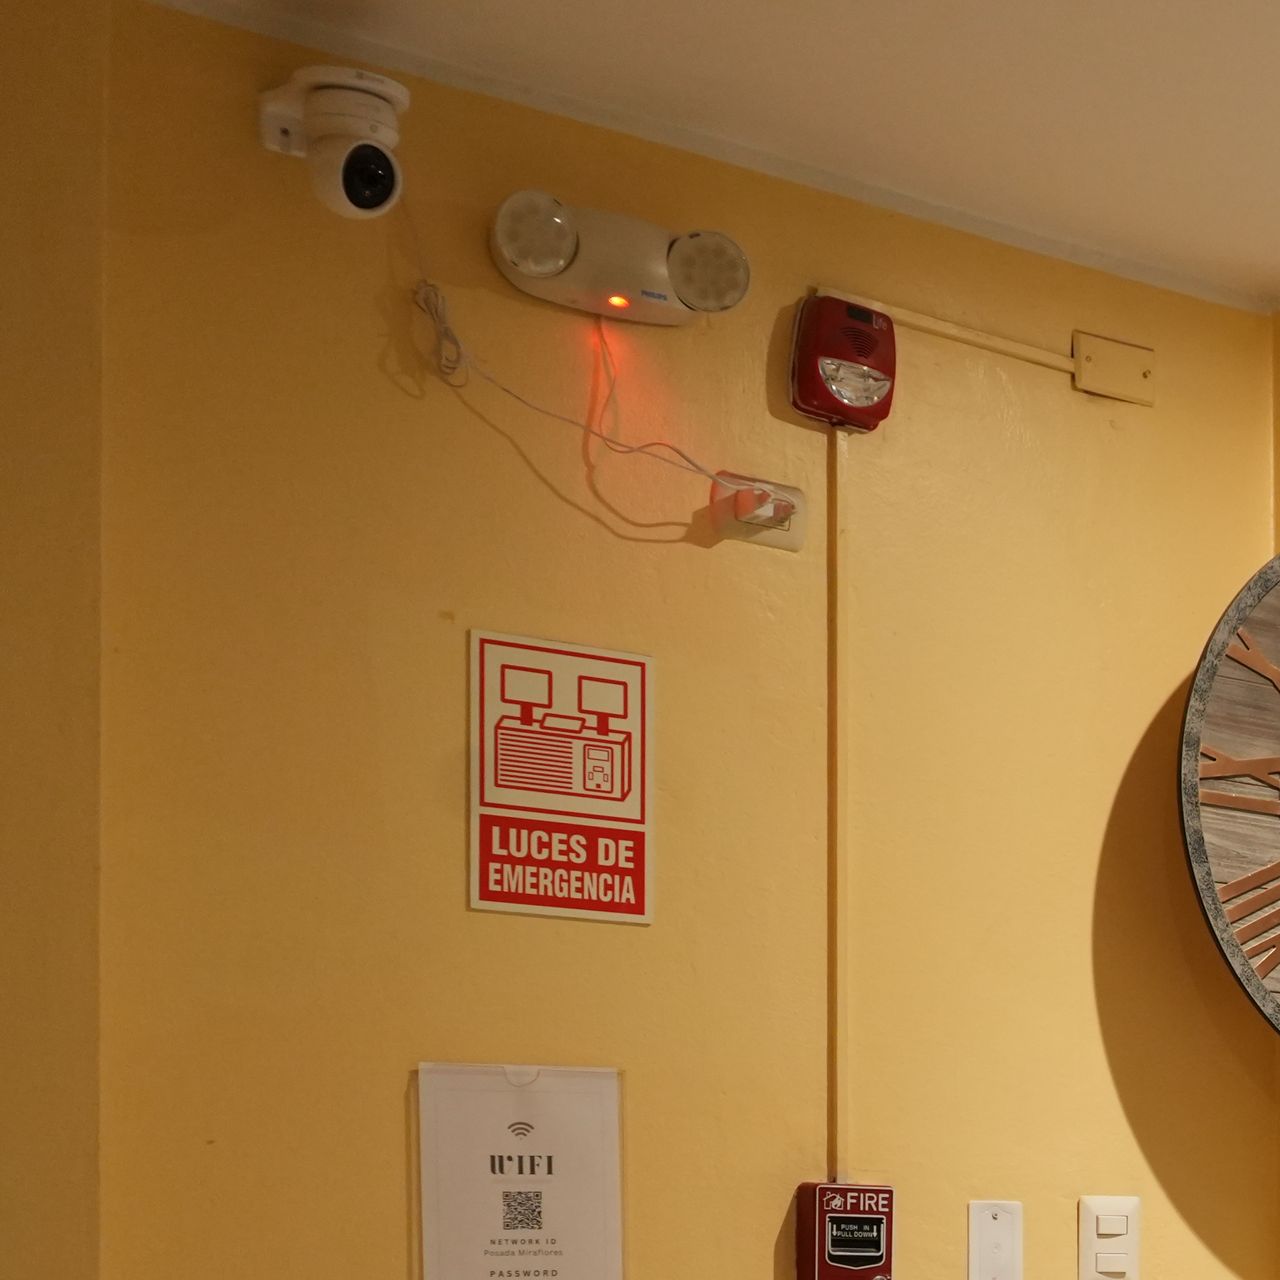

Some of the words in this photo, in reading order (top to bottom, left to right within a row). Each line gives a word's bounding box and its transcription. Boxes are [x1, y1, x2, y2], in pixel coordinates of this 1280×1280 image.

[492, 826, 588, 864] LUCES
[597, 837, 635, 869] DE
[488, 862, 636, 904] EMERGENCIA
[489, 1154, 553, 1175] WIFI
[846, 1191, 890, 1212] FIRE
[841, 1223, 858, 1231] PUSH
[863, 1224, 870, 1232] IN
[836, 1230, 853, 1238] PULL
[853, 1230, 874, 1238] DOWN
[489, 1238, 541, 1246] NETWORK
[545, 1238, 557, 1246] ID
[483, 1249, 516, 1257] Posada
[518, 1248, 564, 1257] Miraflores
[489, 1269, 559, 1278] PASSWORD
